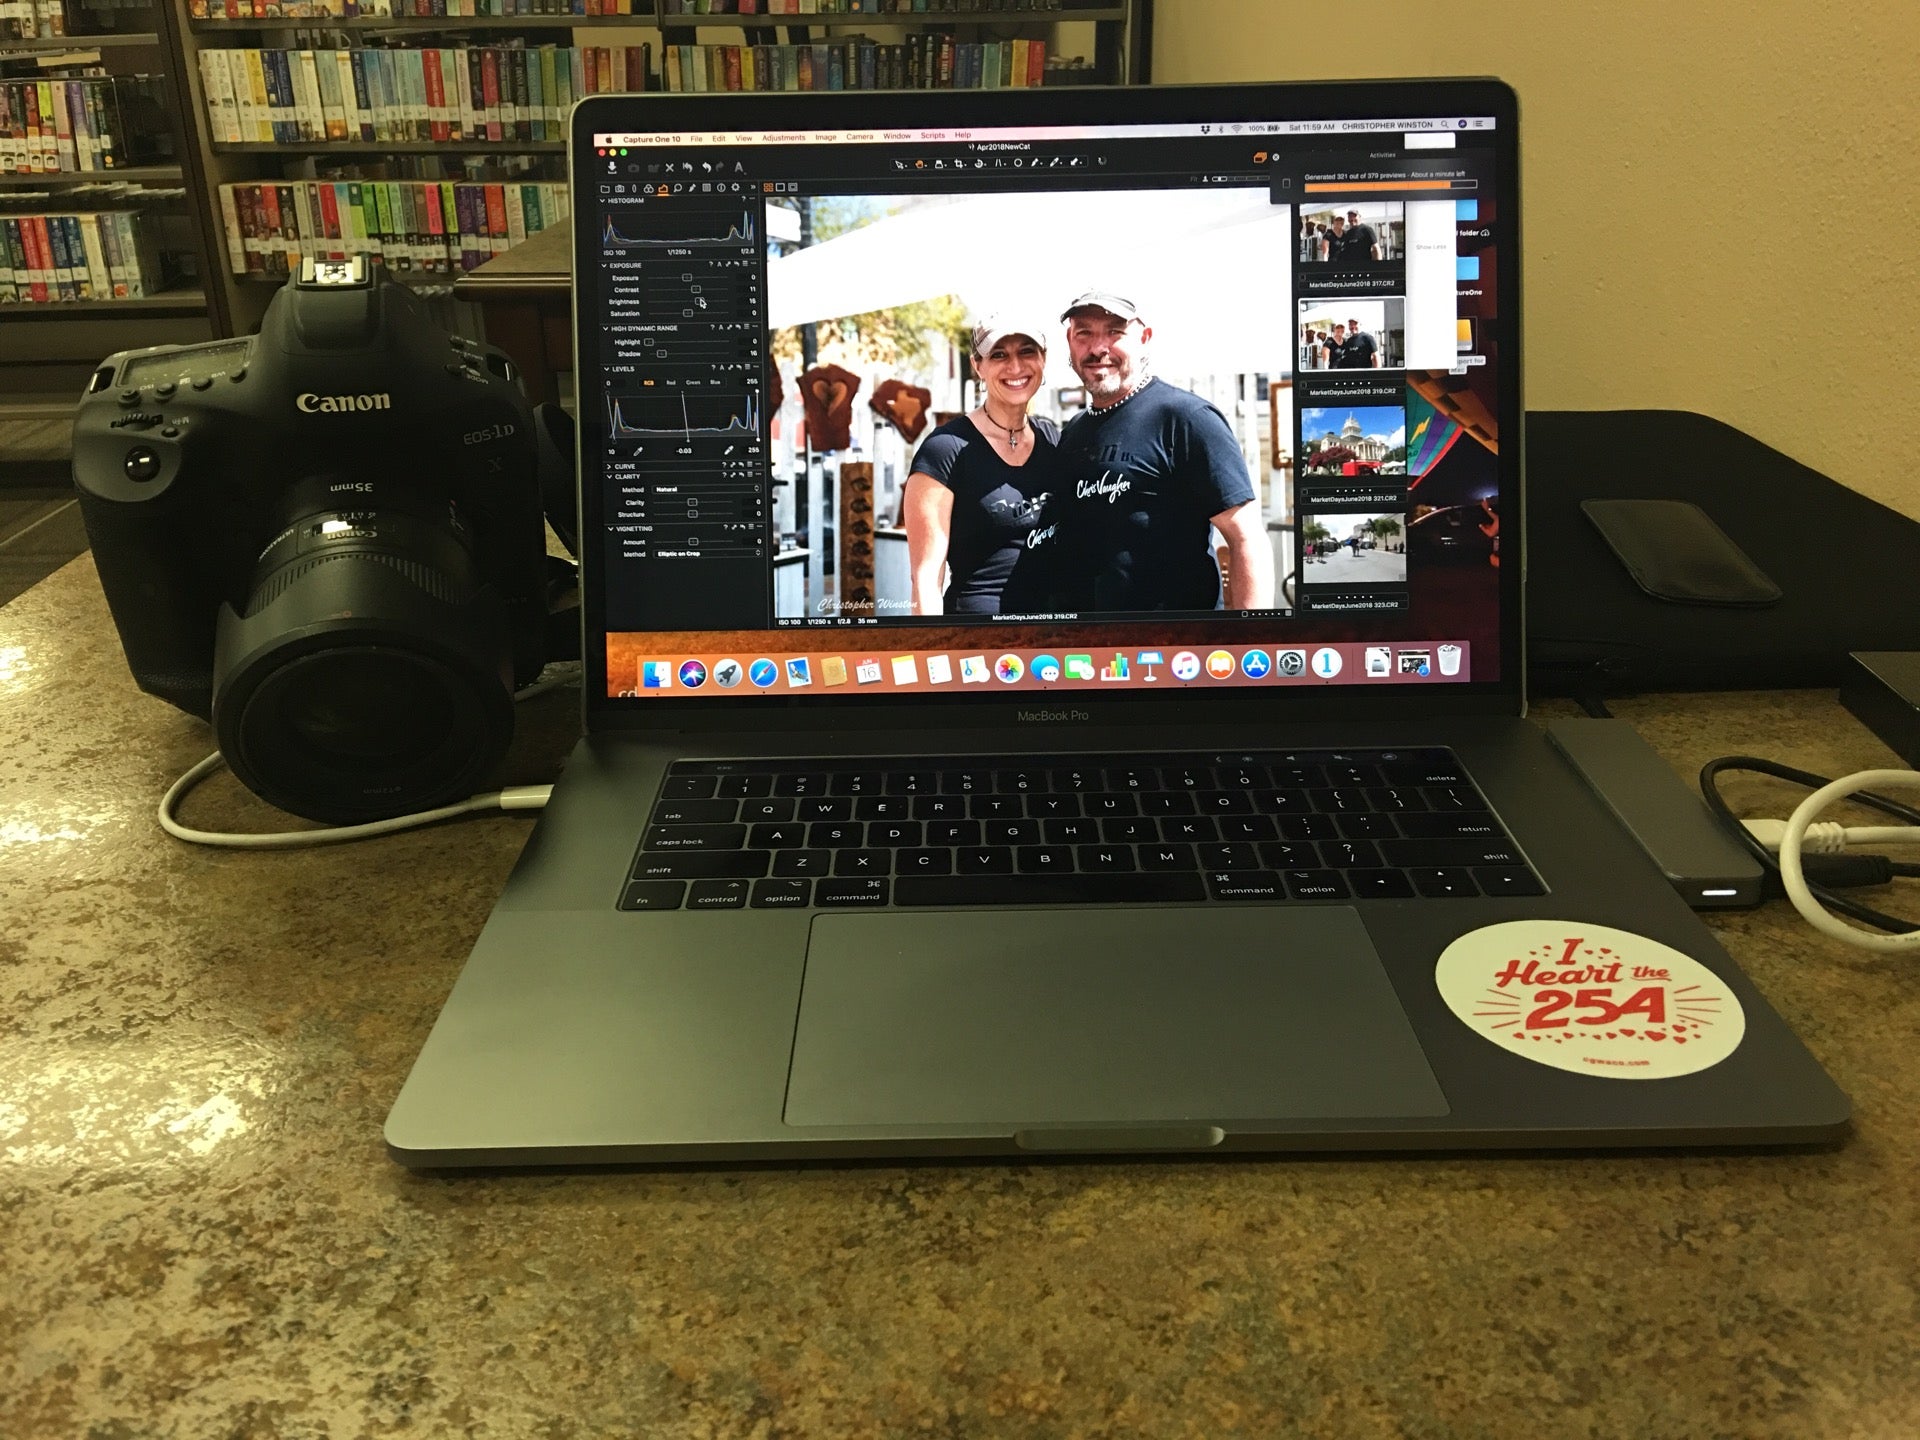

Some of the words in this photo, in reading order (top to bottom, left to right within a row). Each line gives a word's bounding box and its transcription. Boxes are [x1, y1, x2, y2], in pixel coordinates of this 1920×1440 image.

[1342, 122, 1395, 130] CHRISTOPHER
[762, 134, 806, 142] Adjustments
[954, 131, 971, 139] Help
[977, 142, 1031, 151] Apr2018NewCat
[296, 392, 391, 413] Canon
[330, 482, 374, 492] 35mm
[327, 530, 378, 540] Canon
[817, 598, 875, 612] Christopher
[877, 599, 918, 609] Winston
[862, 667, 876, 679] 16
[1017, 710, 1069, 721] MacBook
[1071, 710, 1089, 720] Pro
[1218, 798, 1229, 806] O
[762, 806, 774, 814] Q
[1127, 826, 1135, 834] J
[857, 858, 868, 866] X
[1100, 854, 1112, 862] N
[1160, 853, 1174, 861] M
[826, 893, 880, 901] command
[1556, 938, 1585, 966] I
[1494, 959, 1624, 988] Heart
[1630, 966, 1671, 981] the
[1525, 987, 1665, 1031] 25A
